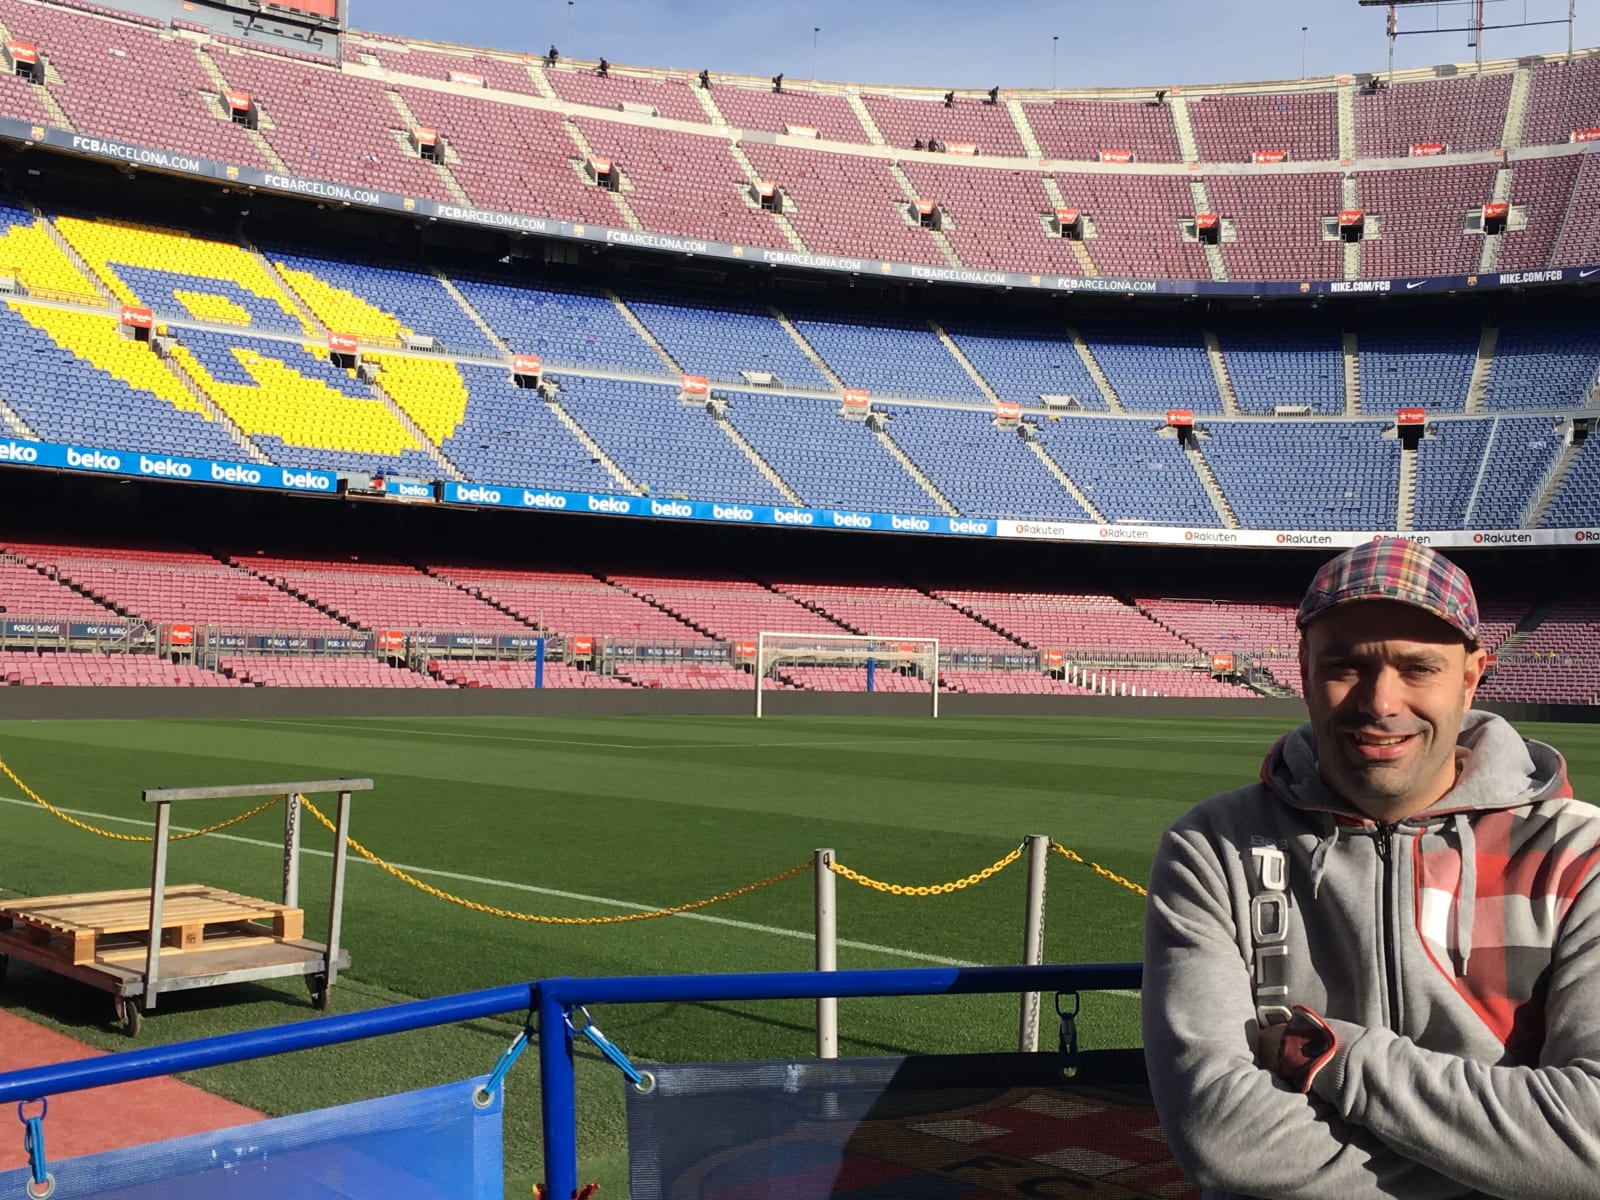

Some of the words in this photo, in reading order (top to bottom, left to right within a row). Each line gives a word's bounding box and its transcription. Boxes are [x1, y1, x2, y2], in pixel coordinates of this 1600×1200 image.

[73, 136, 199, 172] FCBARCELONA.COM
[265, 175, 379, 204] FCBARCELONA.COM
[438, 205, 545, 231] FCBARCELONA.COM
[607, 230, 706, 253] FCBARCELONA.COM
[764, 251, 861, 270] FCBARCELONA.COM
[911, 266, 1005, 283] FCBARCELONA.COM
[1500, 270, 1562, 285] NIKE.COM/FCB
[1058, 278, 1156, 291] FCBARCELONA.COM
[1331, 280, 1391, 292] NIKE.COM/FCB
[0, 442, 37, 461] eko
[67, 447, 121, 470] beko
[140, 455, 192, 478] beko
[211, 462, 261, 484] beko
[282, 469, 330, 489] beko
[399, 484, 429, 496] beko
[457, 486, 500, 503] beko
[523, 491, 567, 508] beko
[588, 496, 630, 513] beko
[652, 500, 692, 516] beko
[713, 504, 753, 521] beko
[774, 508, 813, 525] beko
[833, 512, 872, 528] beko
[891, 516, 930, 531] beko
[949, 519, 988, 534] beko
[1024, 525, 1065, 535] Rakuten
[1108, 529, 1148, 539] Rakuten
[1193, 532, 1237, 542] Rakuten
[1286, 534, 1332, 543] Rakuten
[1484, 533, 1532, 543] Rakuten
